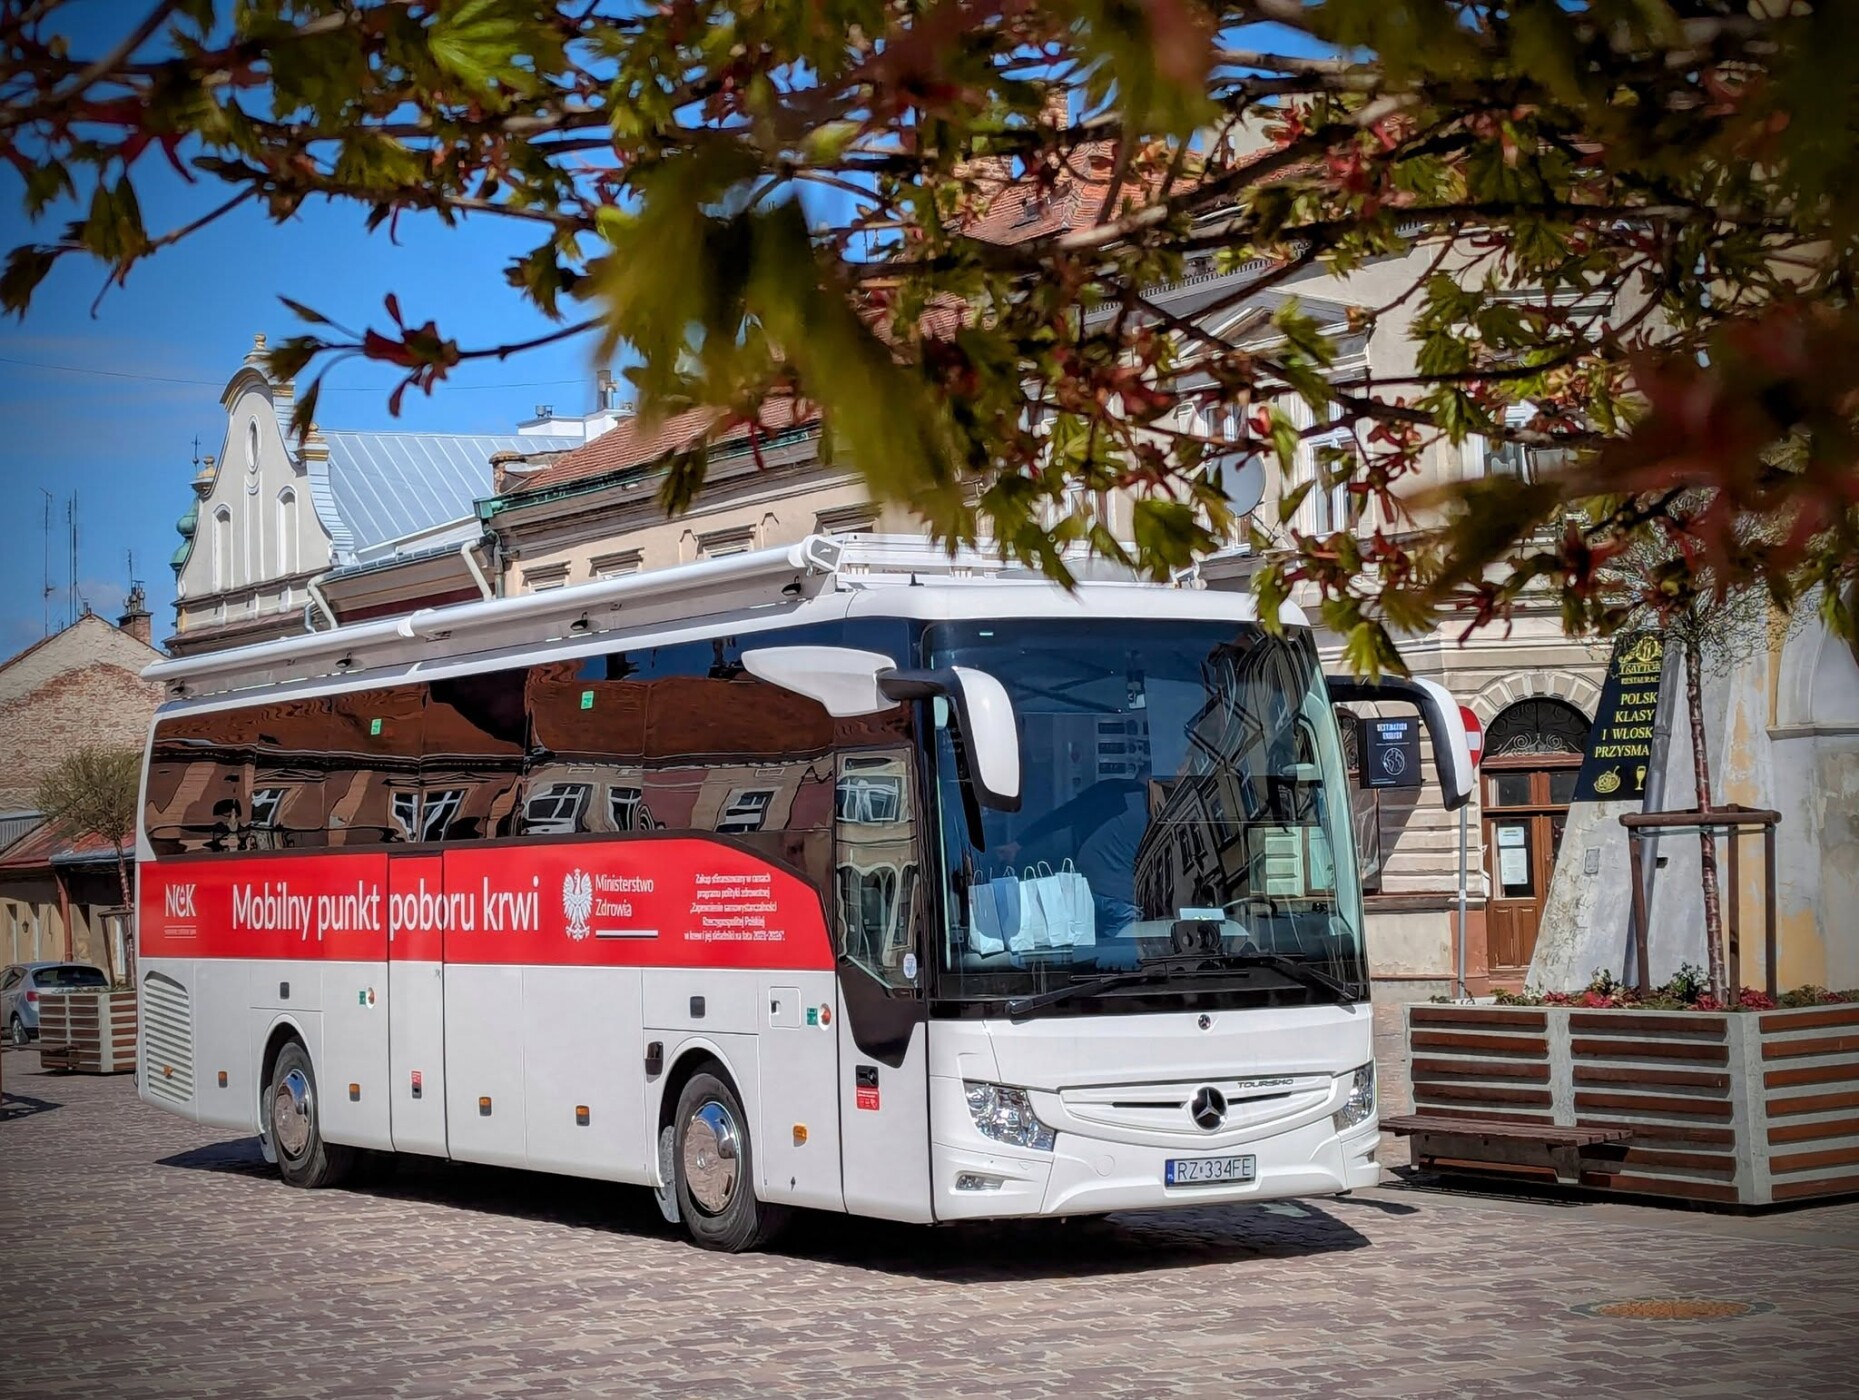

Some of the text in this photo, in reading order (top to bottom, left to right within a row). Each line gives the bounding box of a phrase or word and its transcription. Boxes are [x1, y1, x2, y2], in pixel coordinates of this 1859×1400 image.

[1615, 709, 1655, 722] KLASY
[1602, 729, 1607, 740] I
[1594, 744, 1650, 758] PRZYSMA
[595, 874, 654, 892] Ministerstwo
[232, 875, 539, 941] Mobilny punkt poboru krwi
[595, 898, 632, 917] Zdrowia
[1177, 1158, 1251, 1180] RZ 334FE
